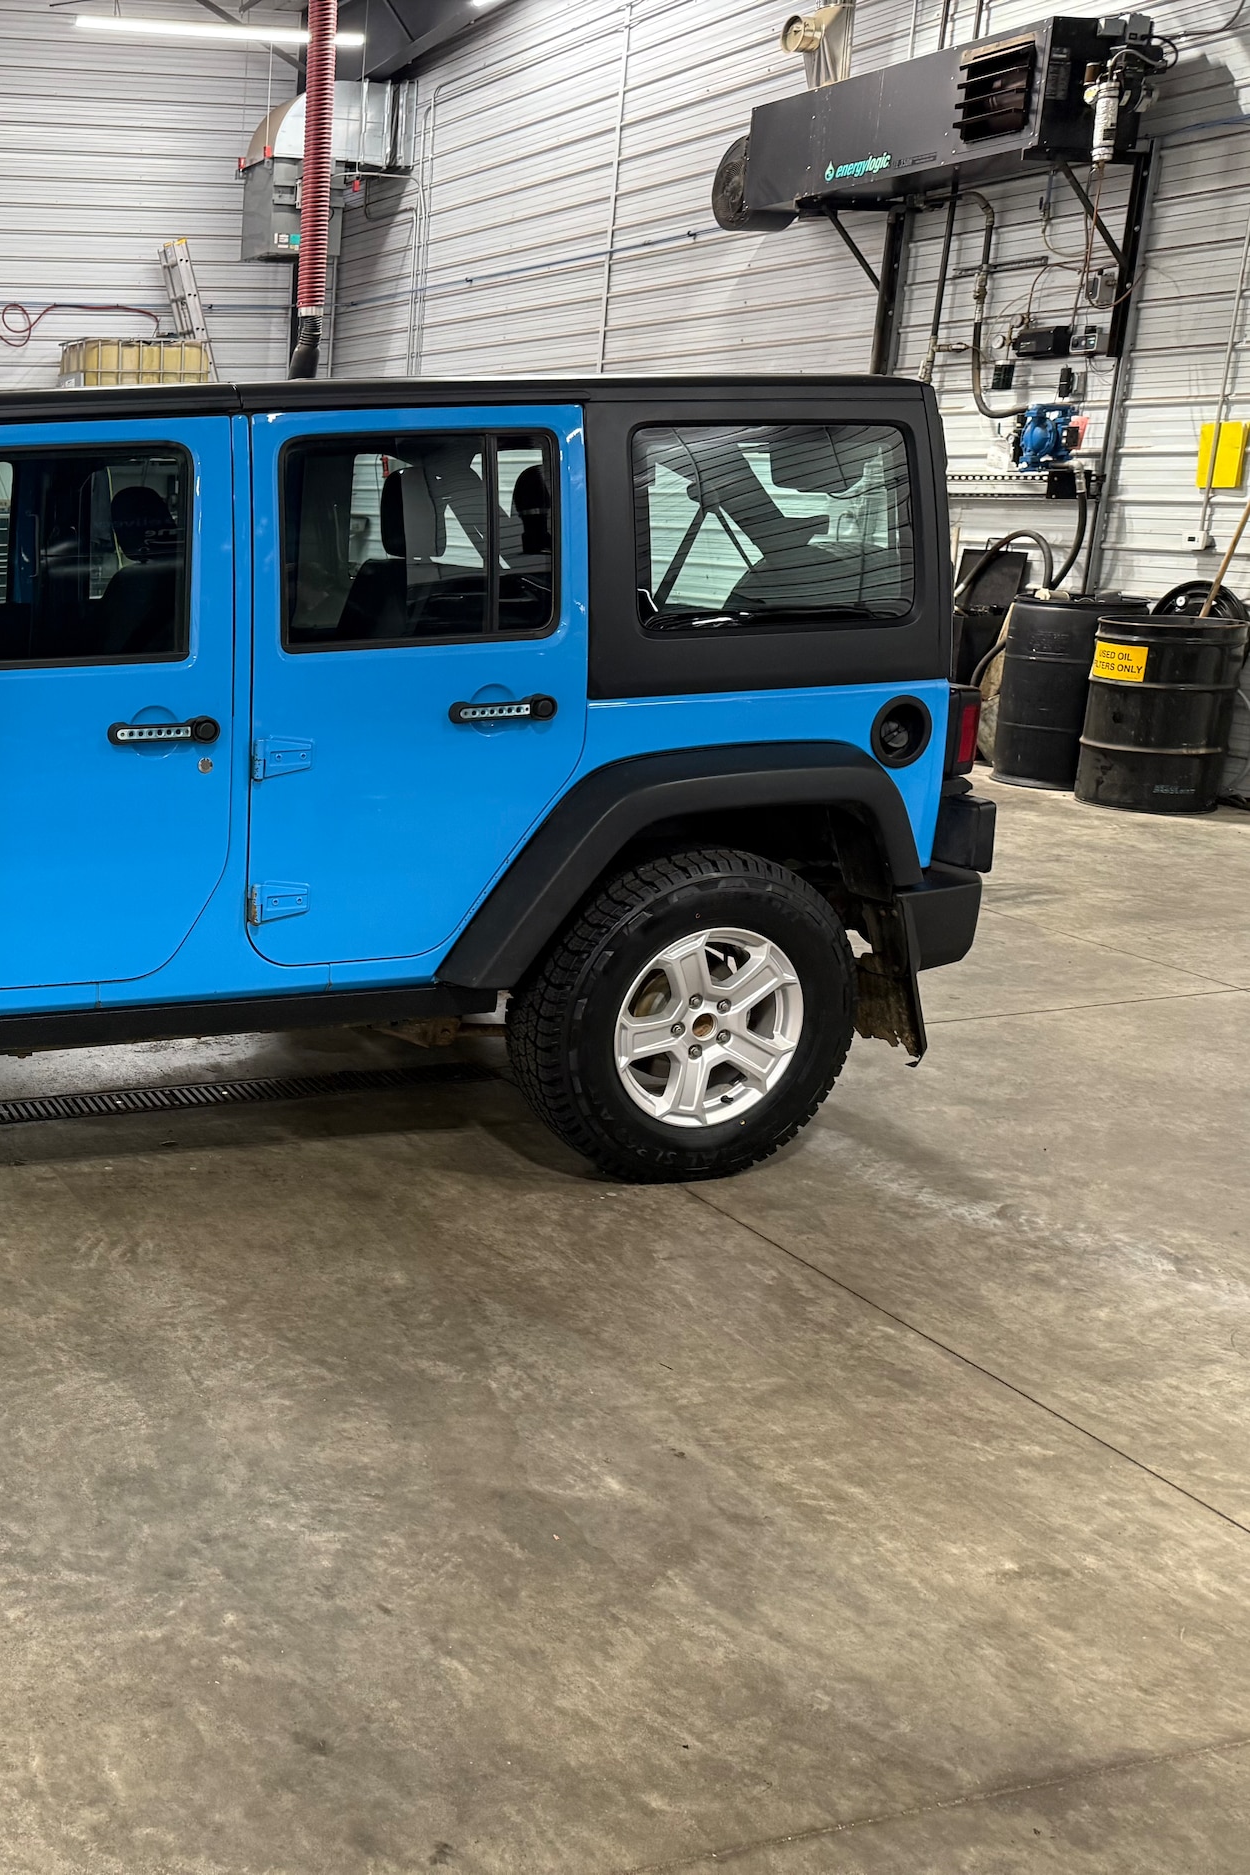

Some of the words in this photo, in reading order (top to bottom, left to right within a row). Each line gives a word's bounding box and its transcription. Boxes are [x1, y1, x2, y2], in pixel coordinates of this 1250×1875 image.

[835, 151, 892, 178] energylogic
[1117, 652, 1132, 661] OIL
[1117, 664, 1143, 673] ONLY
